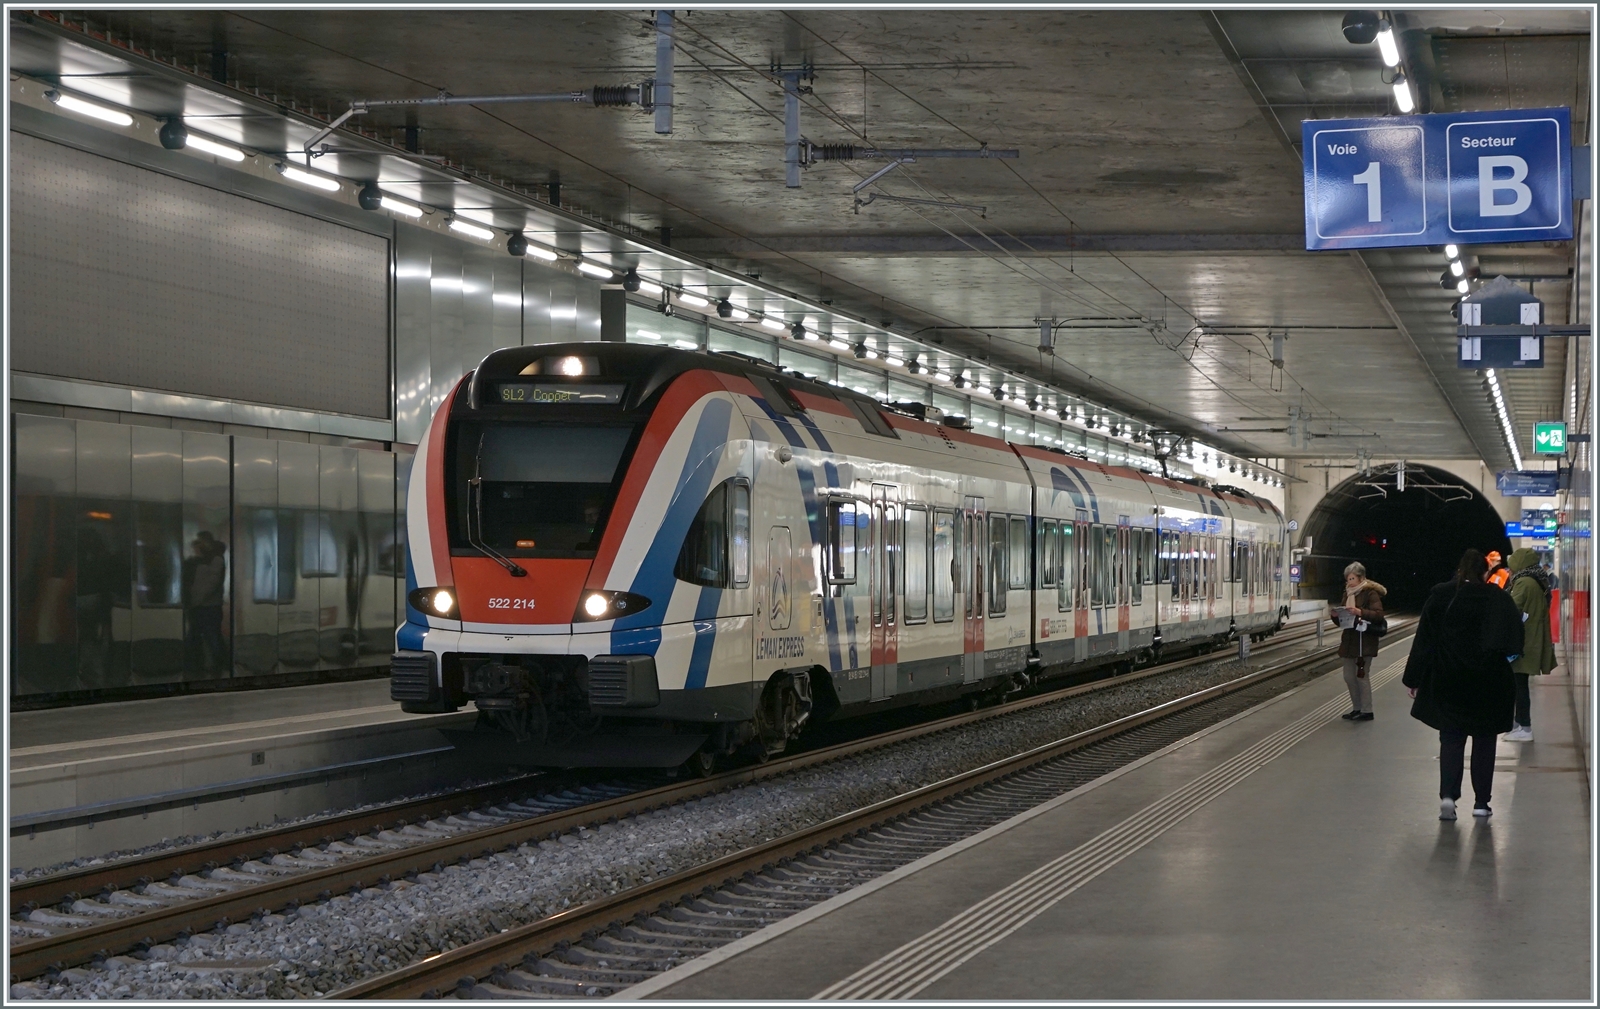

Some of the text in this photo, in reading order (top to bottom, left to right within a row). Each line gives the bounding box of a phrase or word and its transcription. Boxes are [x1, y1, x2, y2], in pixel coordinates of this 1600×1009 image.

[1327, 143, 1358, 156] Voie
[1461, 136, 1516, 149] Secteur
[1353, 161, 1382, 222] 1
[1478, 155, 1533, 217] B
[502, 388, 572, 403] SL2 Coppet
[488, 597, 536, 609] 522 214
[756, 631, 805, 660] LÉMAN EXPRESS
